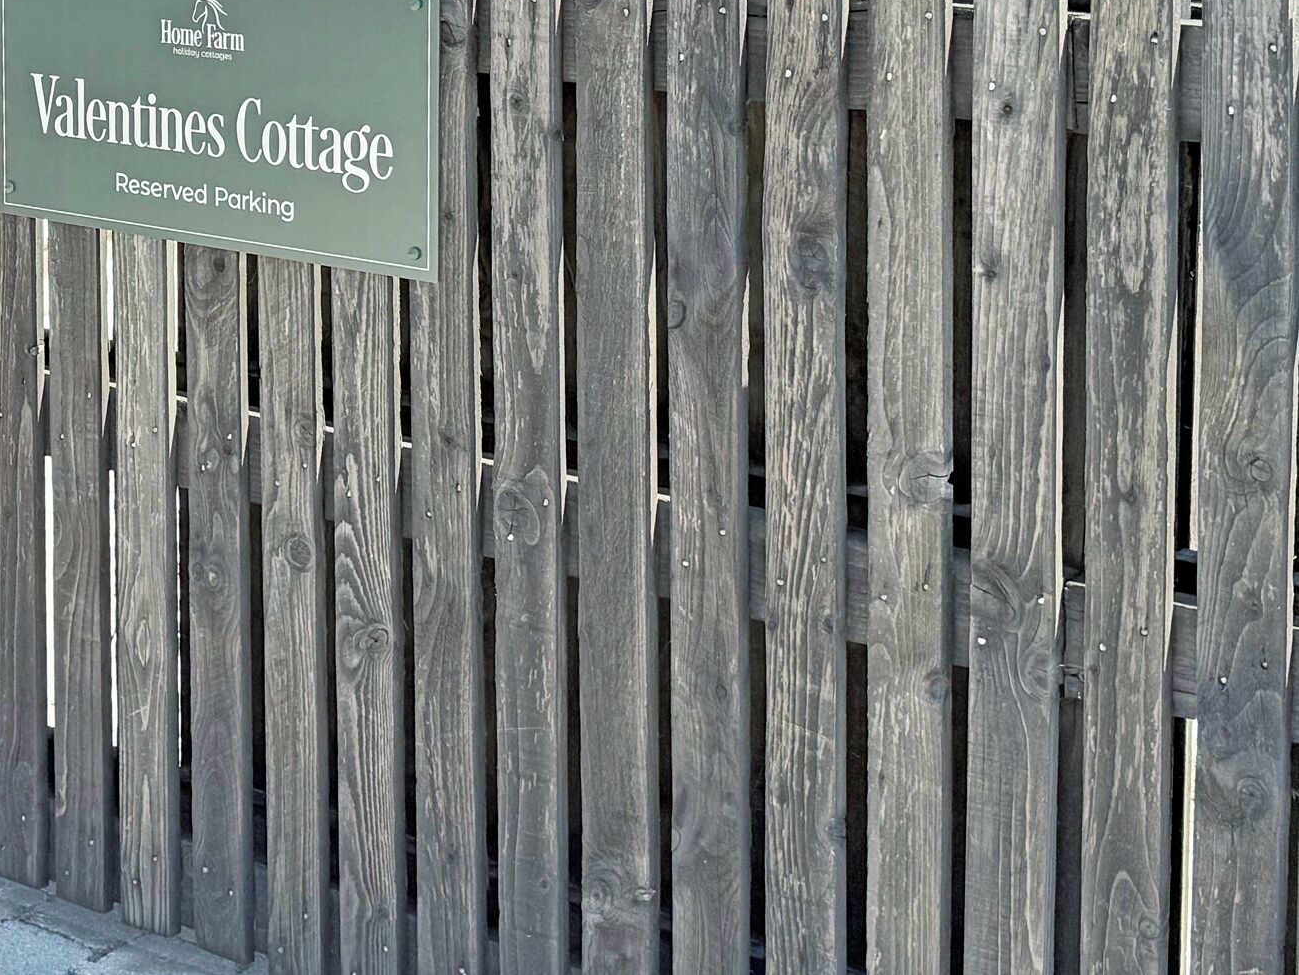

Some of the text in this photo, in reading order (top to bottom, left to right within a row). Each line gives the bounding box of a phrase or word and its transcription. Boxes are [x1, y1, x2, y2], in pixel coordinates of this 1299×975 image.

[160, 19, 245, 52] Home Farm
[173, 47, 232, 61] holiday cottages
[30, 72, 394, 195] Valentines Cottage
[115, 172, 296, 223] Reserved Parking
